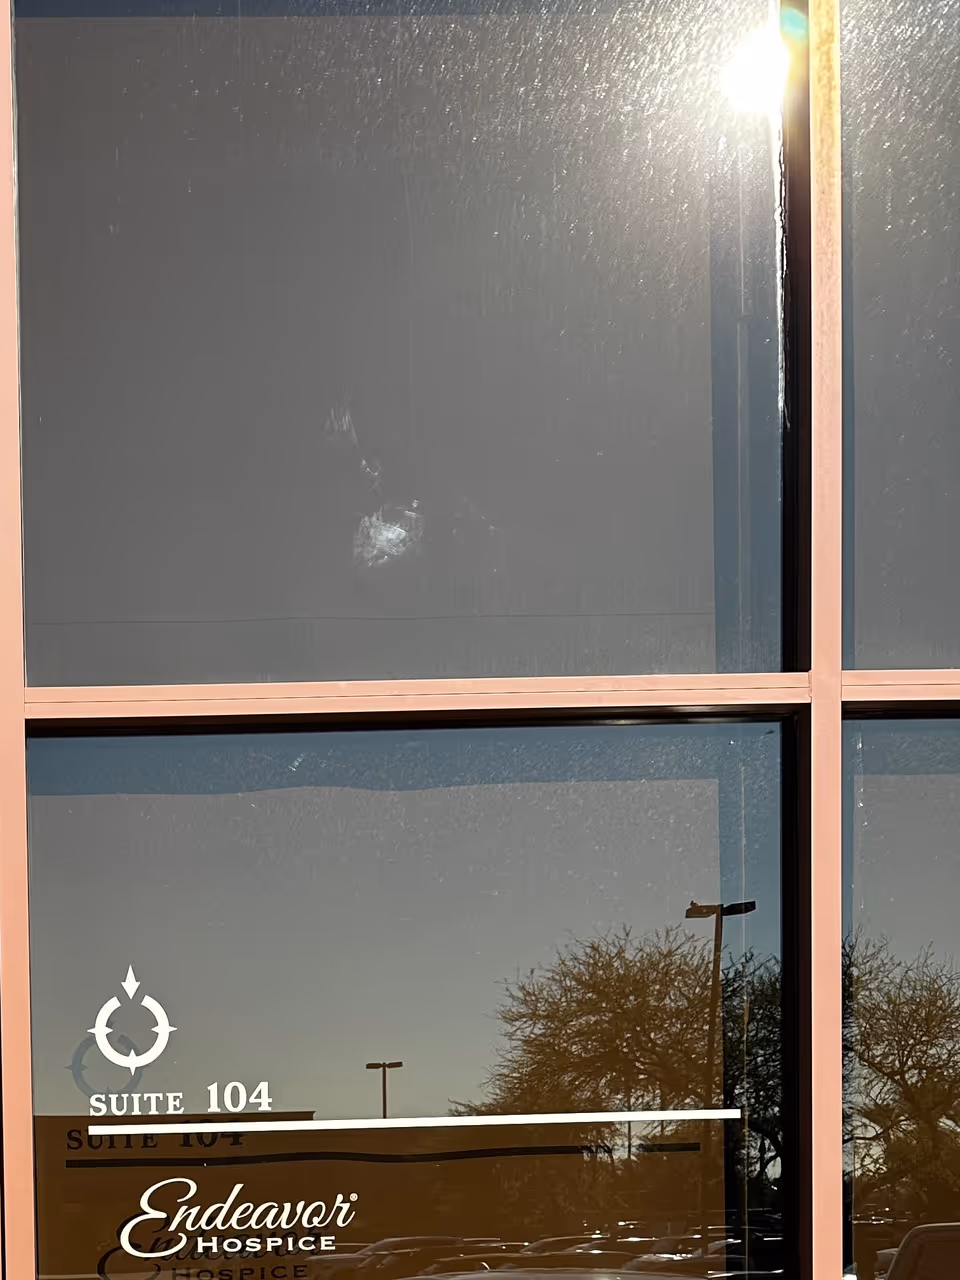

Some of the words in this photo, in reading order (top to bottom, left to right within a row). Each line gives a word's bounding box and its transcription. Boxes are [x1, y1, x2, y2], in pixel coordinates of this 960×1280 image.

[89, 1092, 185, 1117] SUITE
[207, 1081, 273, 1113] 104
[120, 1177, 356, 1258] Endeavor
[197, 1235, 336, 1253] HOSPICE
